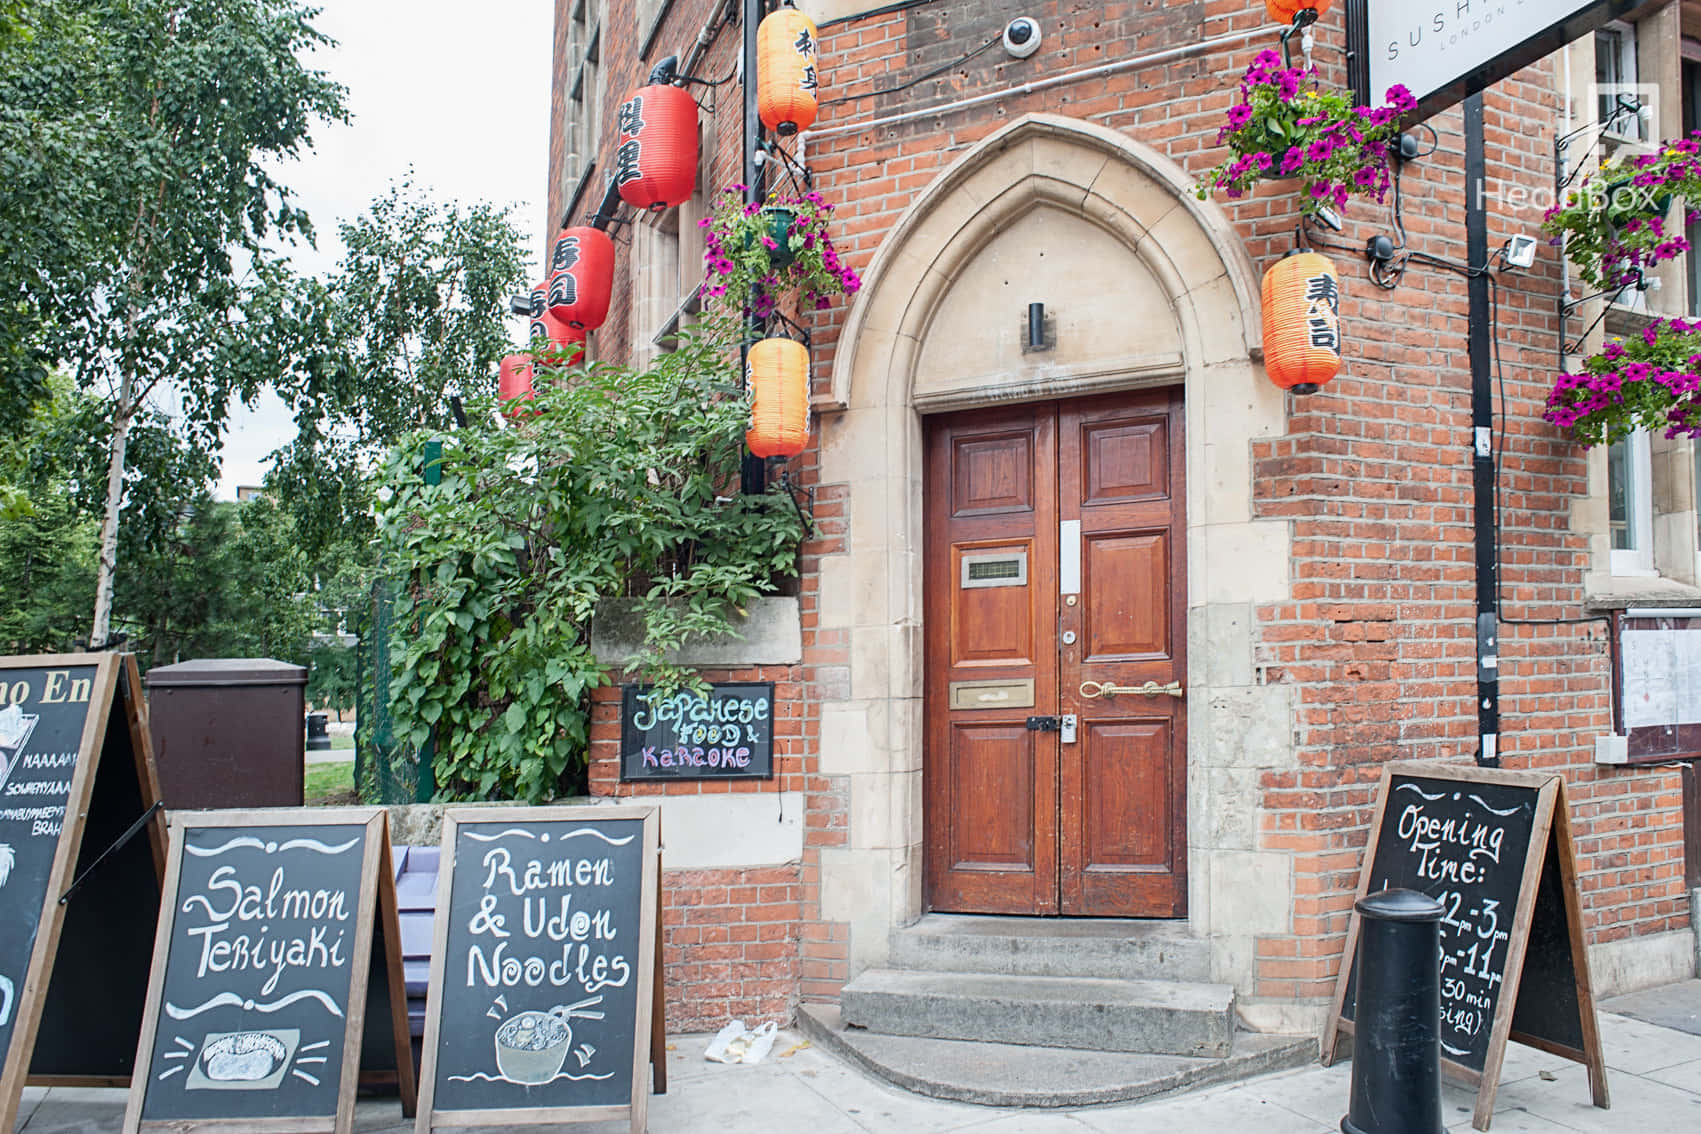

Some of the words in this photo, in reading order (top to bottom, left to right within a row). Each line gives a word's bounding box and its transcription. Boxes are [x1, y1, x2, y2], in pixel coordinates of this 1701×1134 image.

[1440, 7, 1505, 51] LONDON
[38, 671, 91, 704] En
[633, 692, 769, 733] Japanese
[747, 724, 760, 743] &
[1398, 804, 1505, 864] Opening
[482, 847, 614, 895] Ramen
[1410, 841, 1486, 883] Time:
[182, 865, 350, 923] Salmon
[468, 894, 511, 937] &
[523, 893, 617, 940] Udon
[466, 941, 631, 992] Noodles
[1441, 977, 1466, 1001] 30
[1466, 989, 1491, 1009] min
